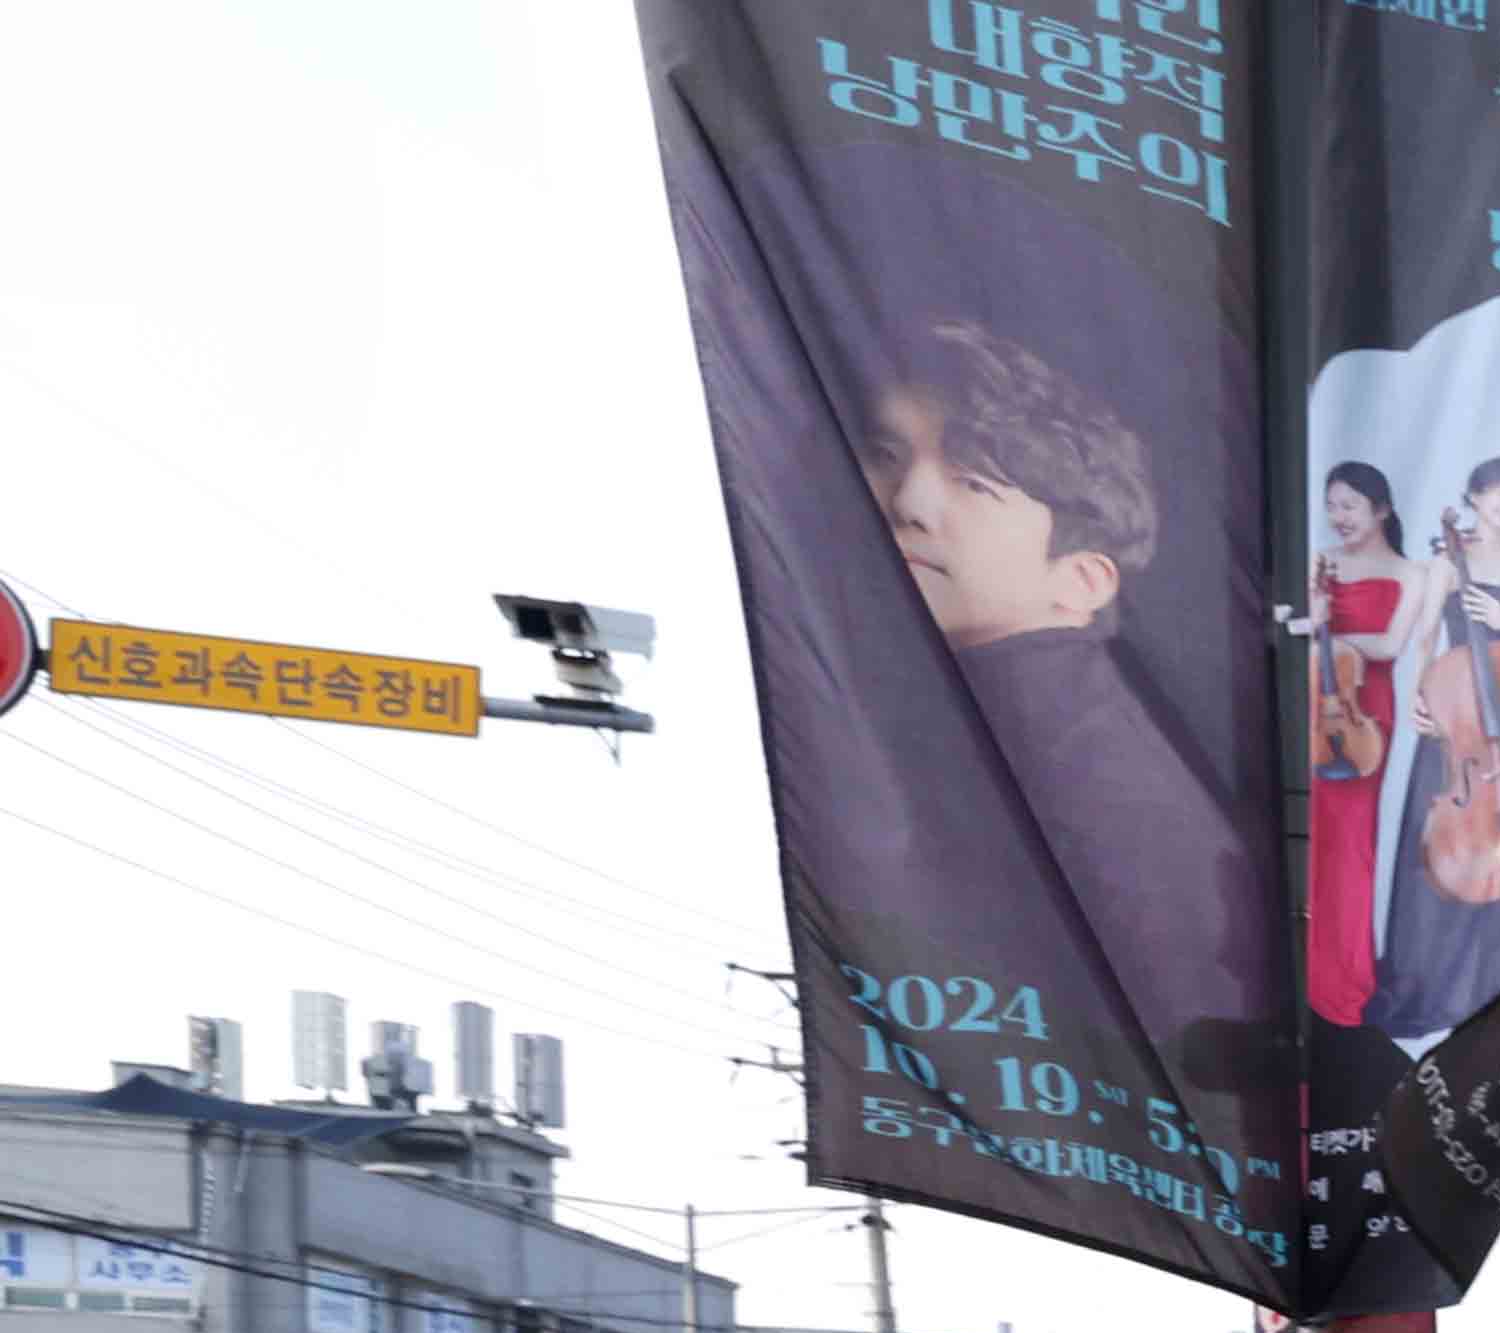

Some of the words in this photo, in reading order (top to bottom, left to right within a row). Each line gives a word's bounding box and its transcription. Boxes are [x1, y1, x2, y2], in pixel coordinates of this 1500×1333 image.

[928, 0, 1226, 142] 내향적
[816, 36, 1233, 229] 낭만주의
[68, 633, 464, 724] 신호과속단속장비
[842, 963, 1049, 1041] 2024
